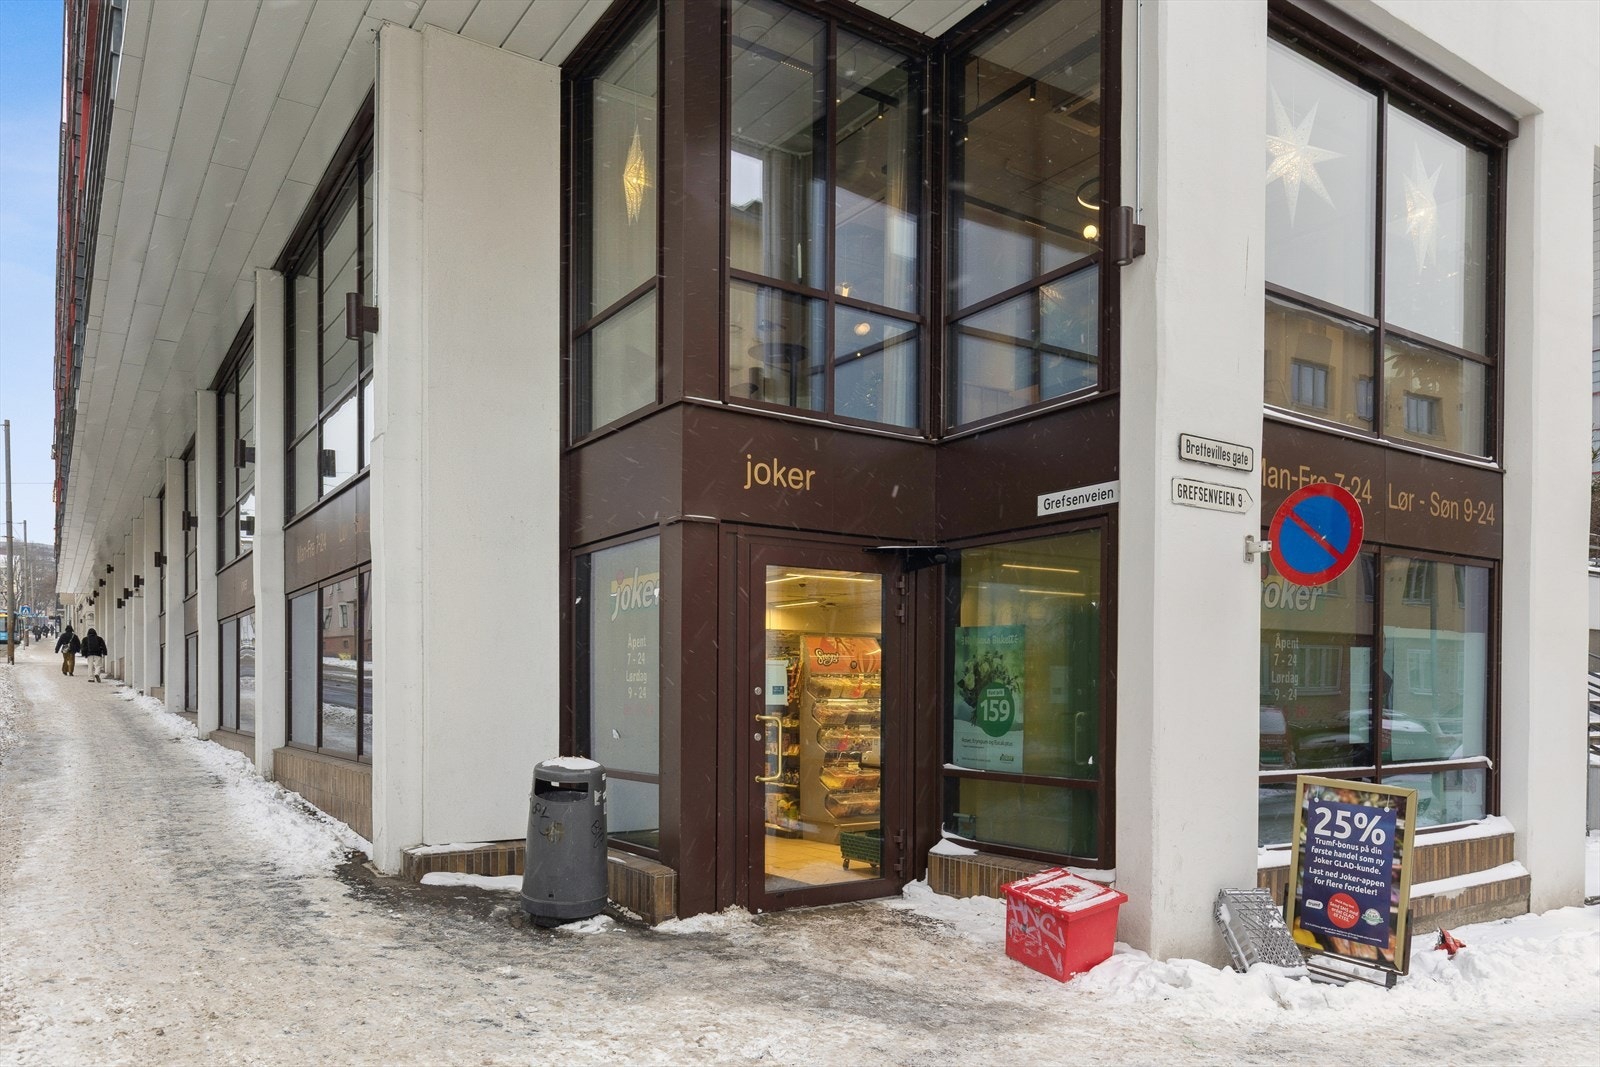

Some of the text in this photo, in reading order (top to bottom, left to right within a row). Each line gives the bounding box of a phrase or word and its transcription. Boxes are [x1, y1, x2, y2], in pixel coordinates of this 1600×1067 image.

[1186, 439, 1249, 466] Brettevilles gate
[744, 454, 816, 491] joker
[1044, 488, 1114, 510] Grefsenveien
[1178, 484, 1243, 508] GREFSENVEIEN 9
[1388, 482, 1415, 512] Lør
[1430, 492, 1459, 520] Søn
[1464, 498, 1496, 526] 9-24
[1261, 566, 1323, 611] oker
[1272, 671, 1299, 686] Lørdag
[980, 700, 1010, 722] 159
[1314, 807, 1386, 845] 25%
[1312, 846, 1333, 856] første
[1334, 850, 1358, 860] handel
[1315, 838, 1382, 855] Trumf-bonus på din
[1314, 856, 1381, 875] Joker GLAD-kunde.
[1309, 867, 1385, 888] Last ned Joker-appen
[1314, 877, 1378, 896] for flere fordeler!
